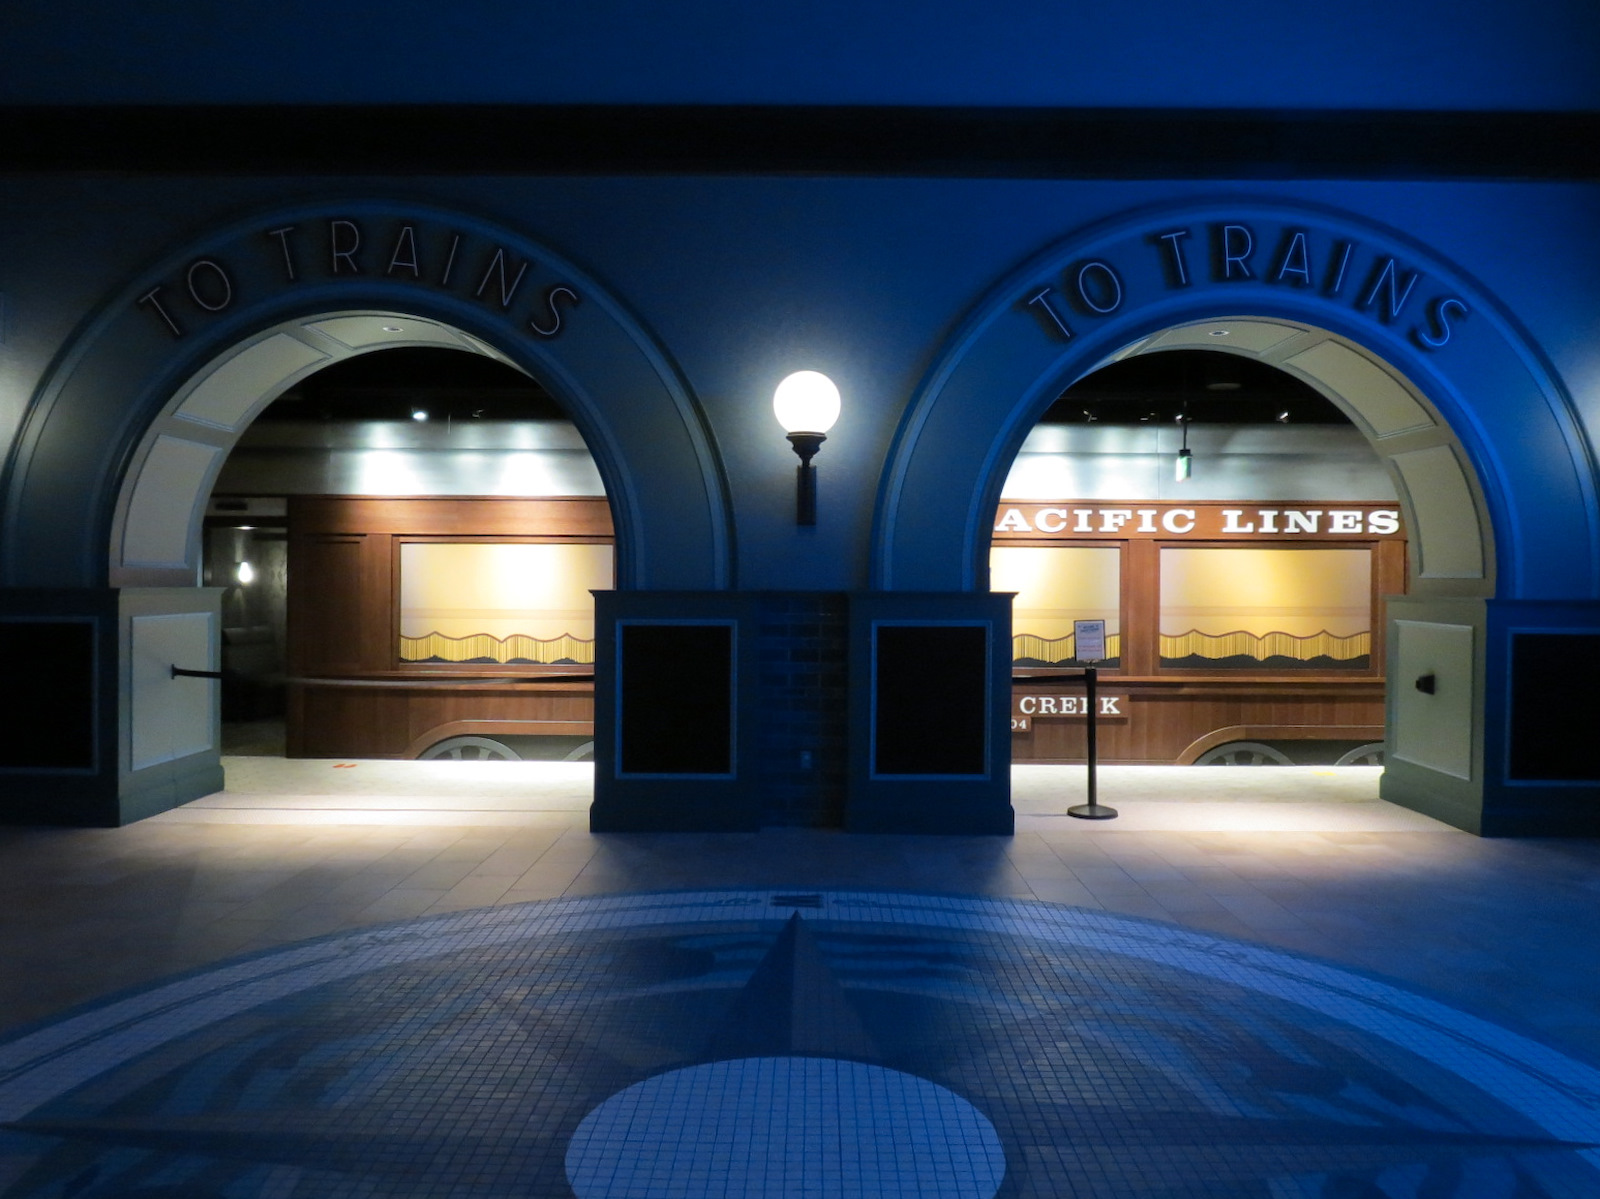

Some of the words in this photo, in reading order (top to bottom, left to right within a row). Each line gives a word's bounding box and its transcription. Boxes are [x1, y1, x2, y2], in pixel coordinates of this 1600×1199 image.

[136, 257, 234, 338] TO
[267, 218, 579, 338] TRAINS
[1026, 260, 1123, 339] TO
[1158, 224, 1469, 348] TRAINS
[994, 508, 1196, 534] ACIFIC
[1222, 508, 1400, 535] LINES
